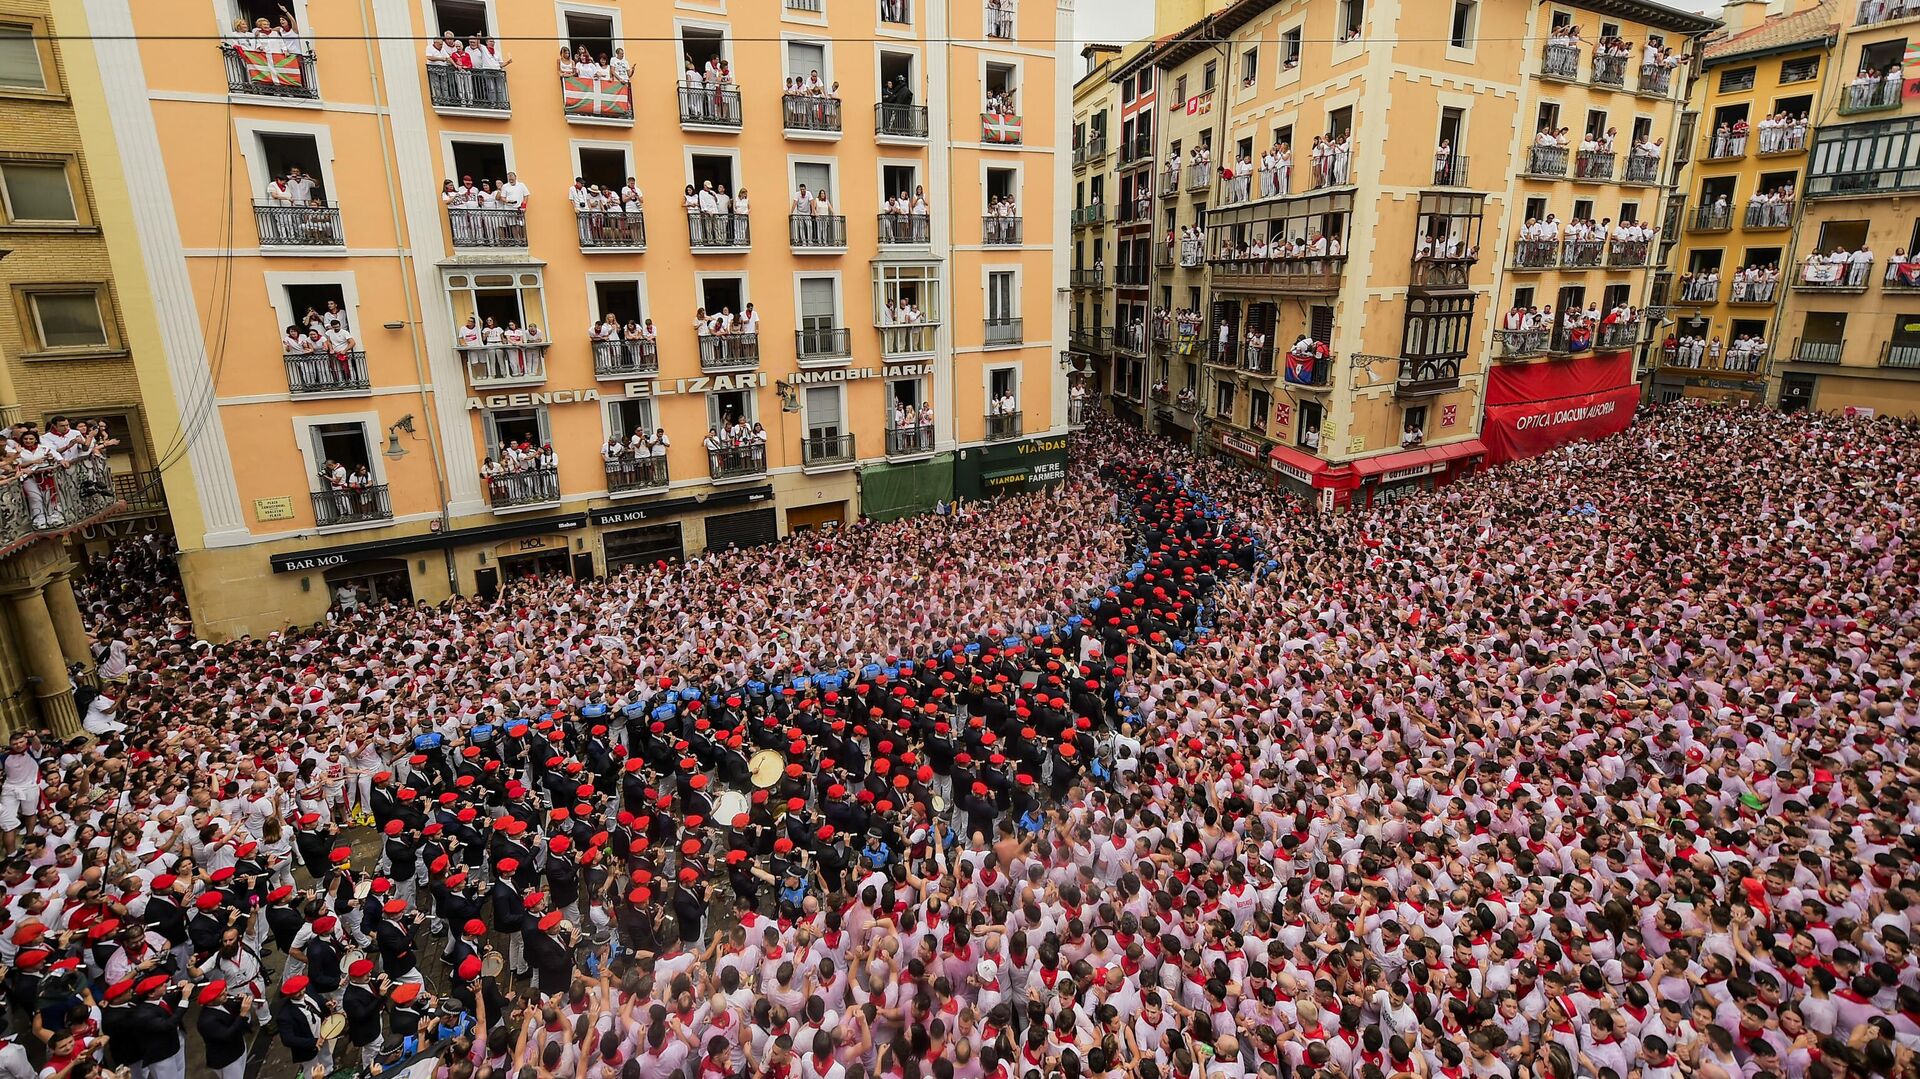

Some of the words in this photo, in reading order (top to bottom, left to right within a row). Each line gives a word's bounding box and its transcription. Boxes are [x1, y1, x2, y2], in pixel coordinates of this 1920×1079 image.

[464, 389, 600, 410] AGENCIA
[625, 373, 767, 398] ELIZARI
[788, 364, 936, 384] INMOBILIARIA
[1517, 414, 1550, 430] OPTICA
[1018, 440, 1066, 455] VIANDAS
[1028, 470, 1065, 483] FARMERS
[1276, 461, 1307, 480] GUTIERREZ
[1389, 466, 1423, 479] GUTIERREZ
[990, 474, 1025, 485] VIANDAS
[601, 514, 622, 524] BAR
[624, 511, 647, 521] MOL
[520, 538, 545, 550] MOL
[286, 559, 315, 571] BAR
[316, 555, 348, 566] MOL
